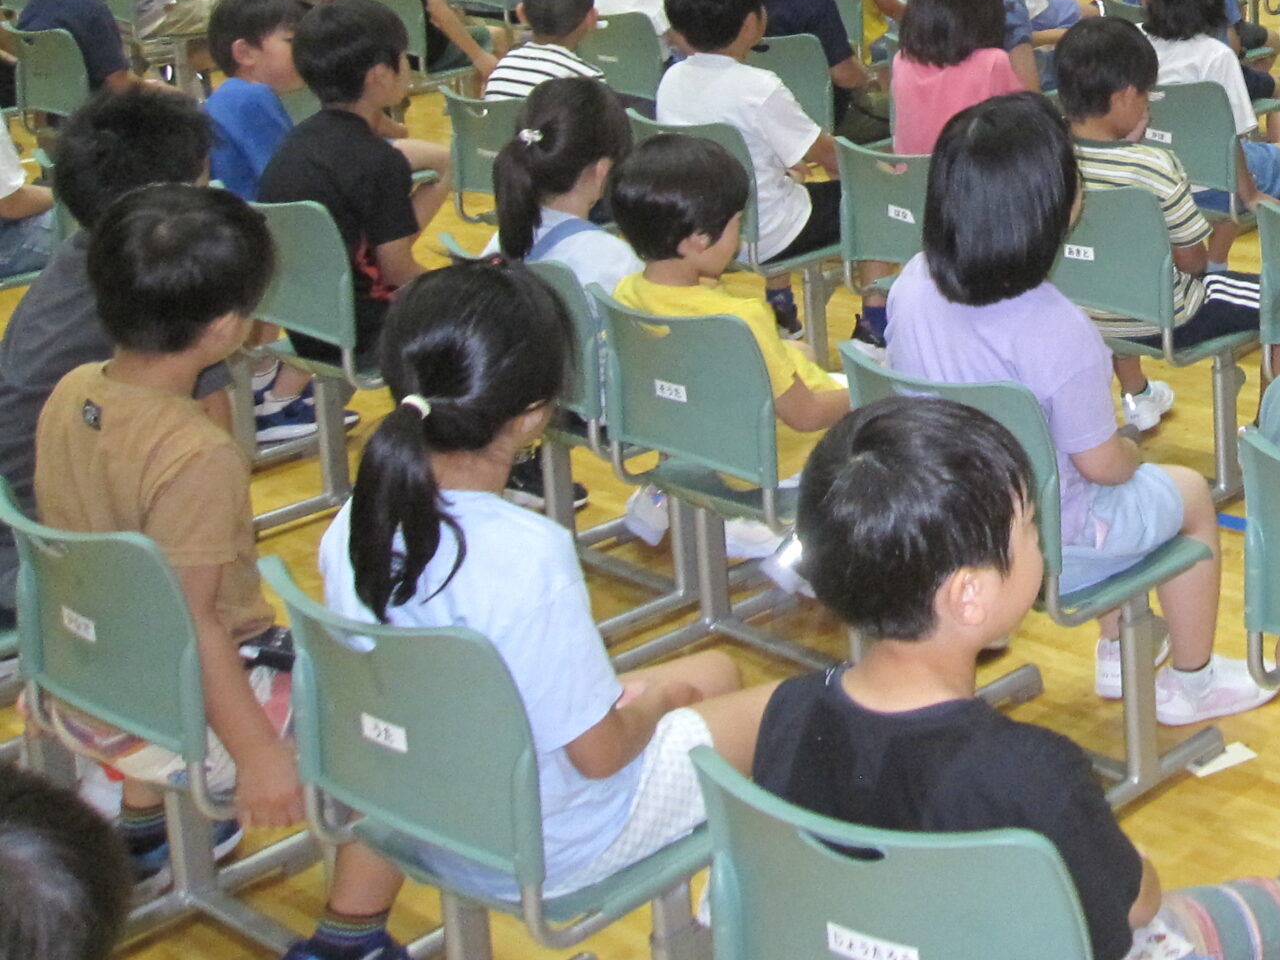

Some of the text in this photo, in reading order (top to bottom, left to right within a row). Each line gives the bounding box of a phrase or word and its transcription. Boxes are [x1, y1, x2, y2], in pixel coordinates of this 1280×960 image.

[1067, 246, 1090, 259] あきと
[659, 383, 683, 400] そうた
